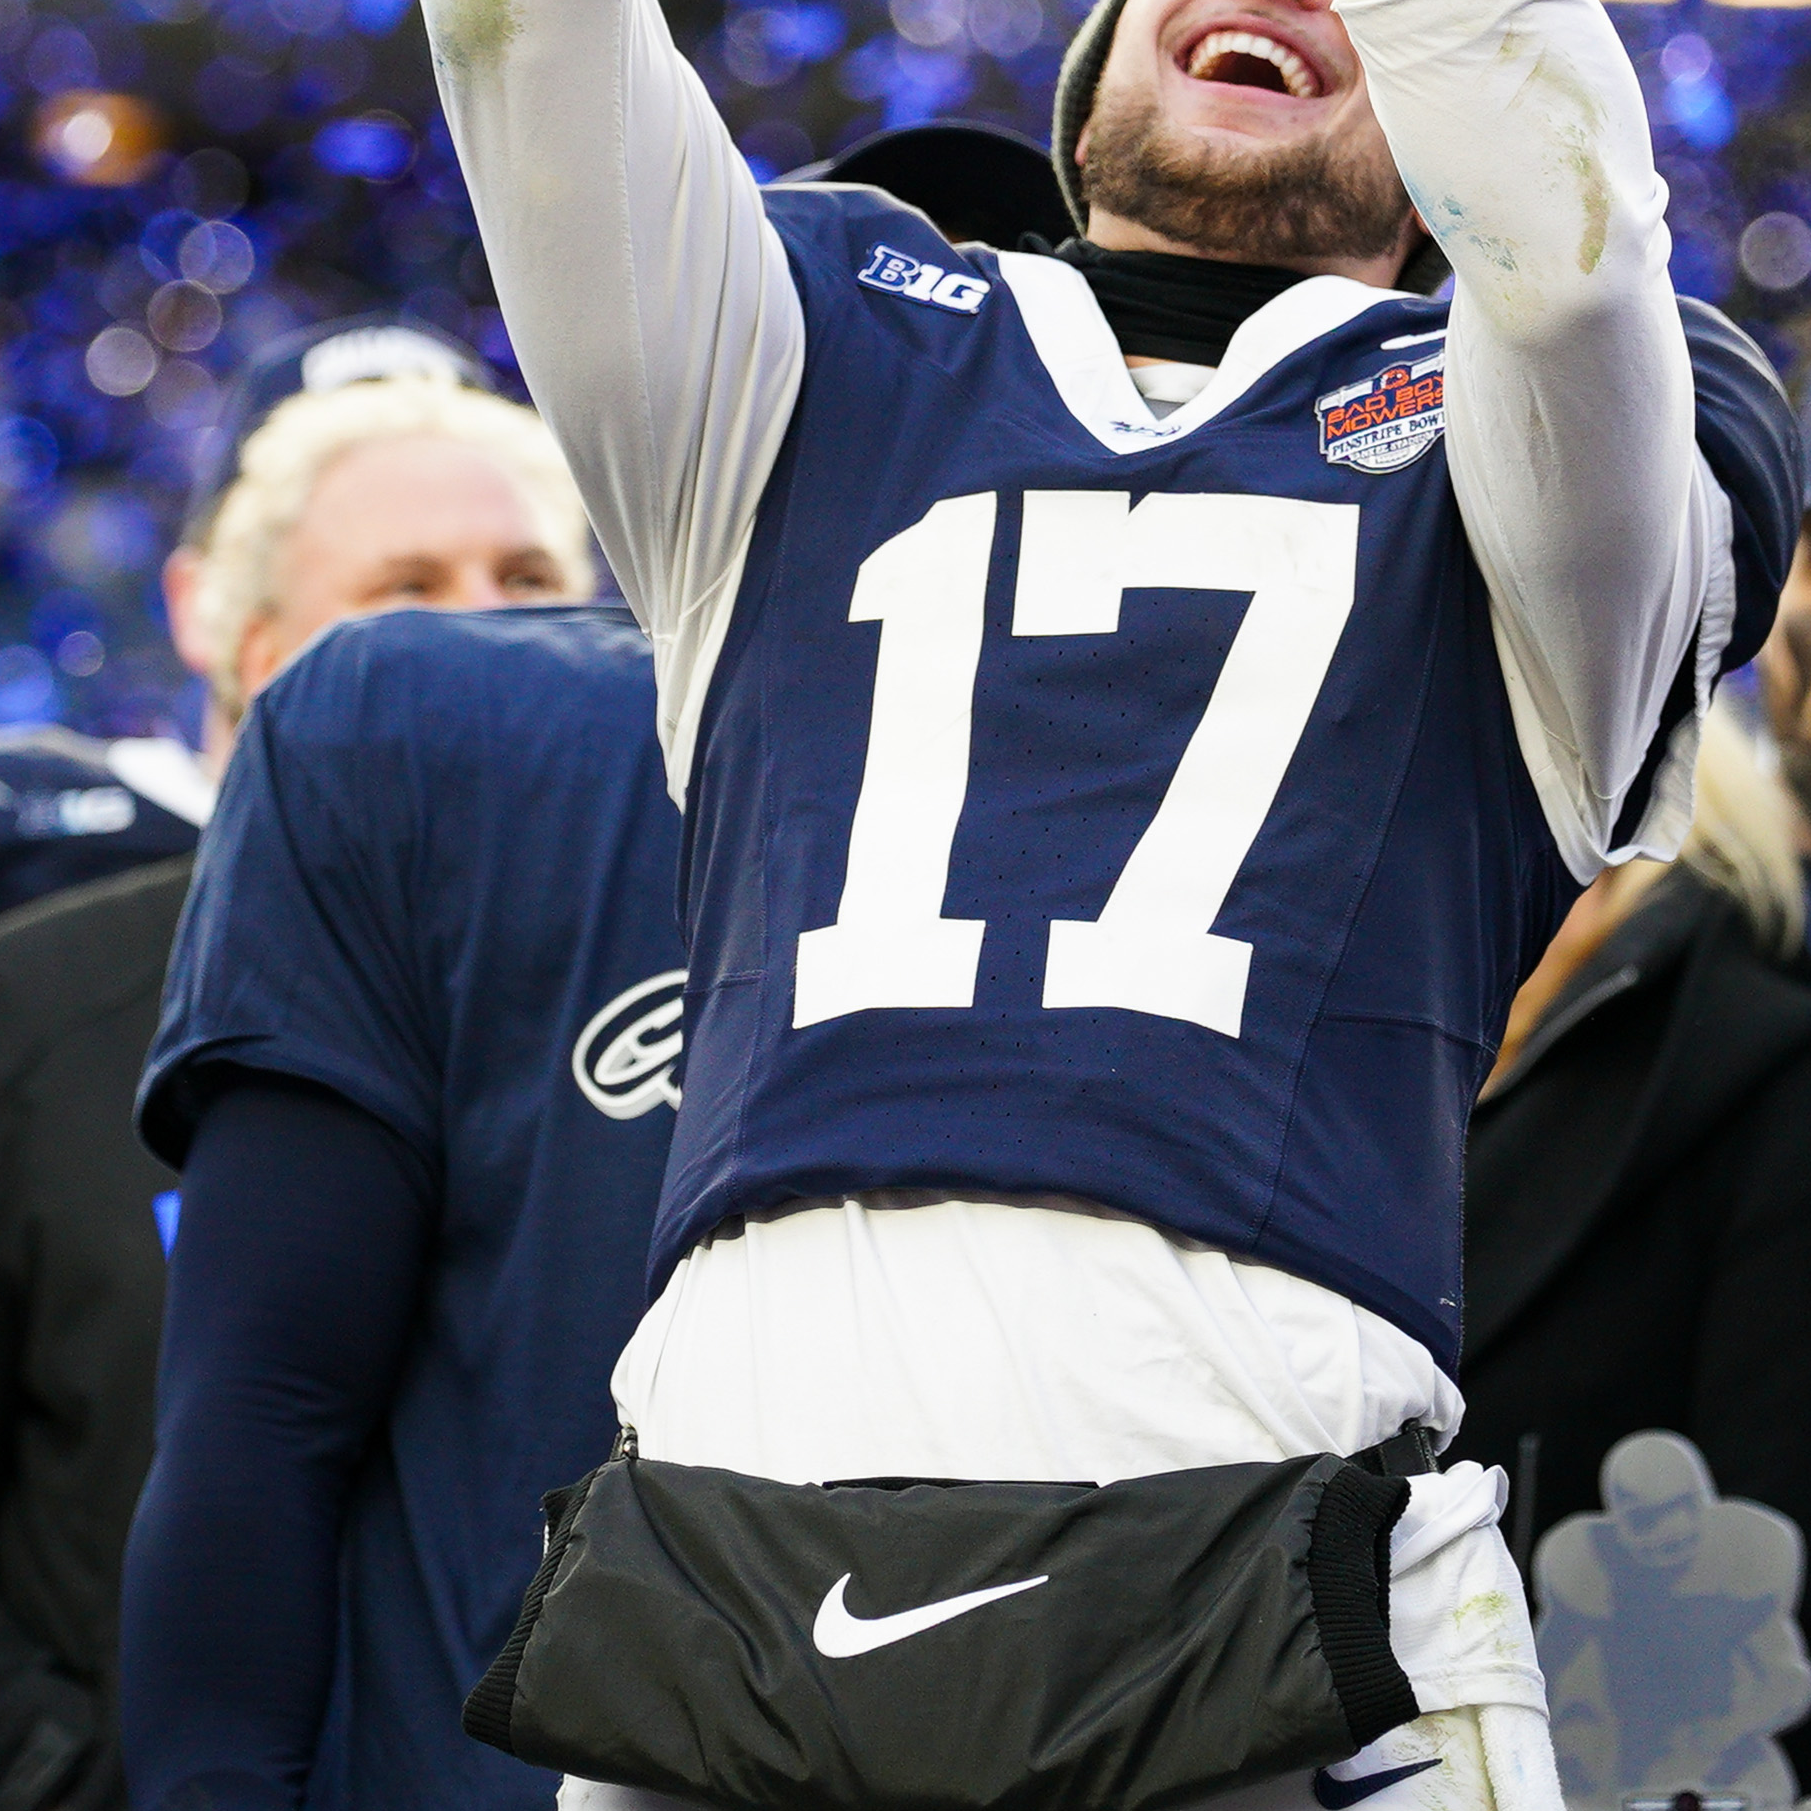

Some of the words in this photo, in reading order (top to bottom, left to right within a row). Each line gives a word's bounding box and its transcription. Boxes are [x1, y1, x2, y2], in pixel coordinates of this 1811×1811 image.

[1327, 395, 1386, 424] BAD
[1333, 424, 1402, 457] PINSTRIPE
[793, 490, 1360, 1038] 17
